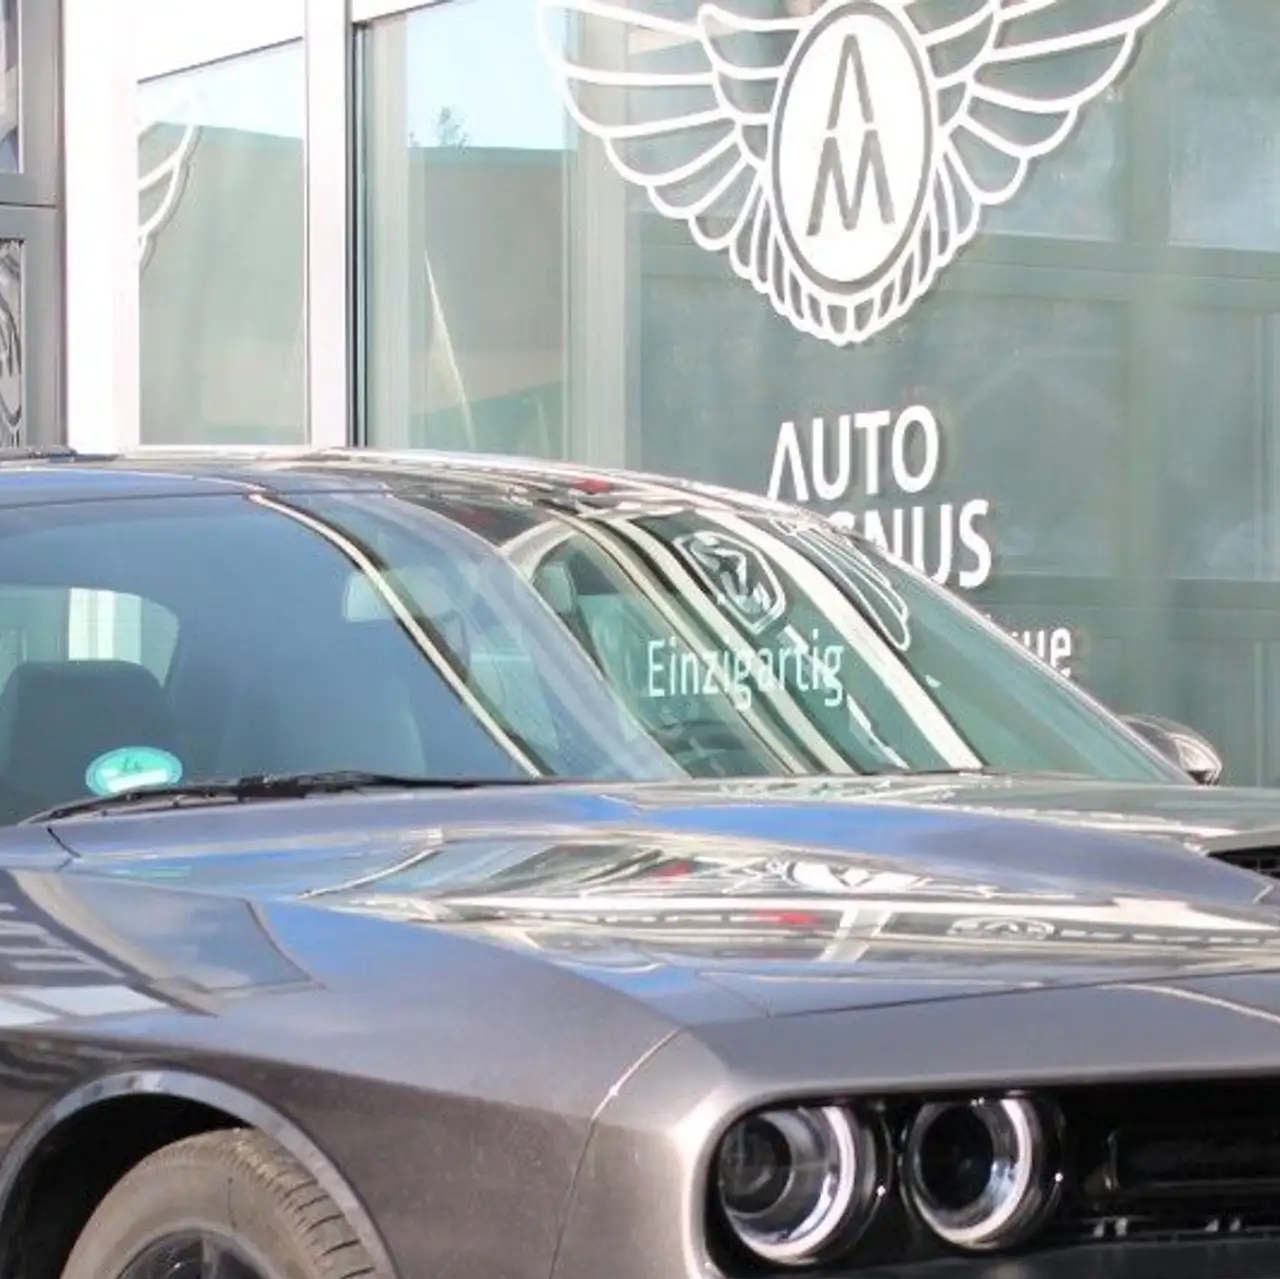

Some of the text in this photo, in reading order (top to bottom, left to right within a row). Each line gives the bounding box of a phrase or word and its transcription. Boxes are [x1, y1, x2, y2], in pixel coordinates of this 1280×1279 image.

[767, 405, 939, 502] AUTO
[828, 499, 992, 589] NUS
[647, 629, 846, 712] Einzigartig
